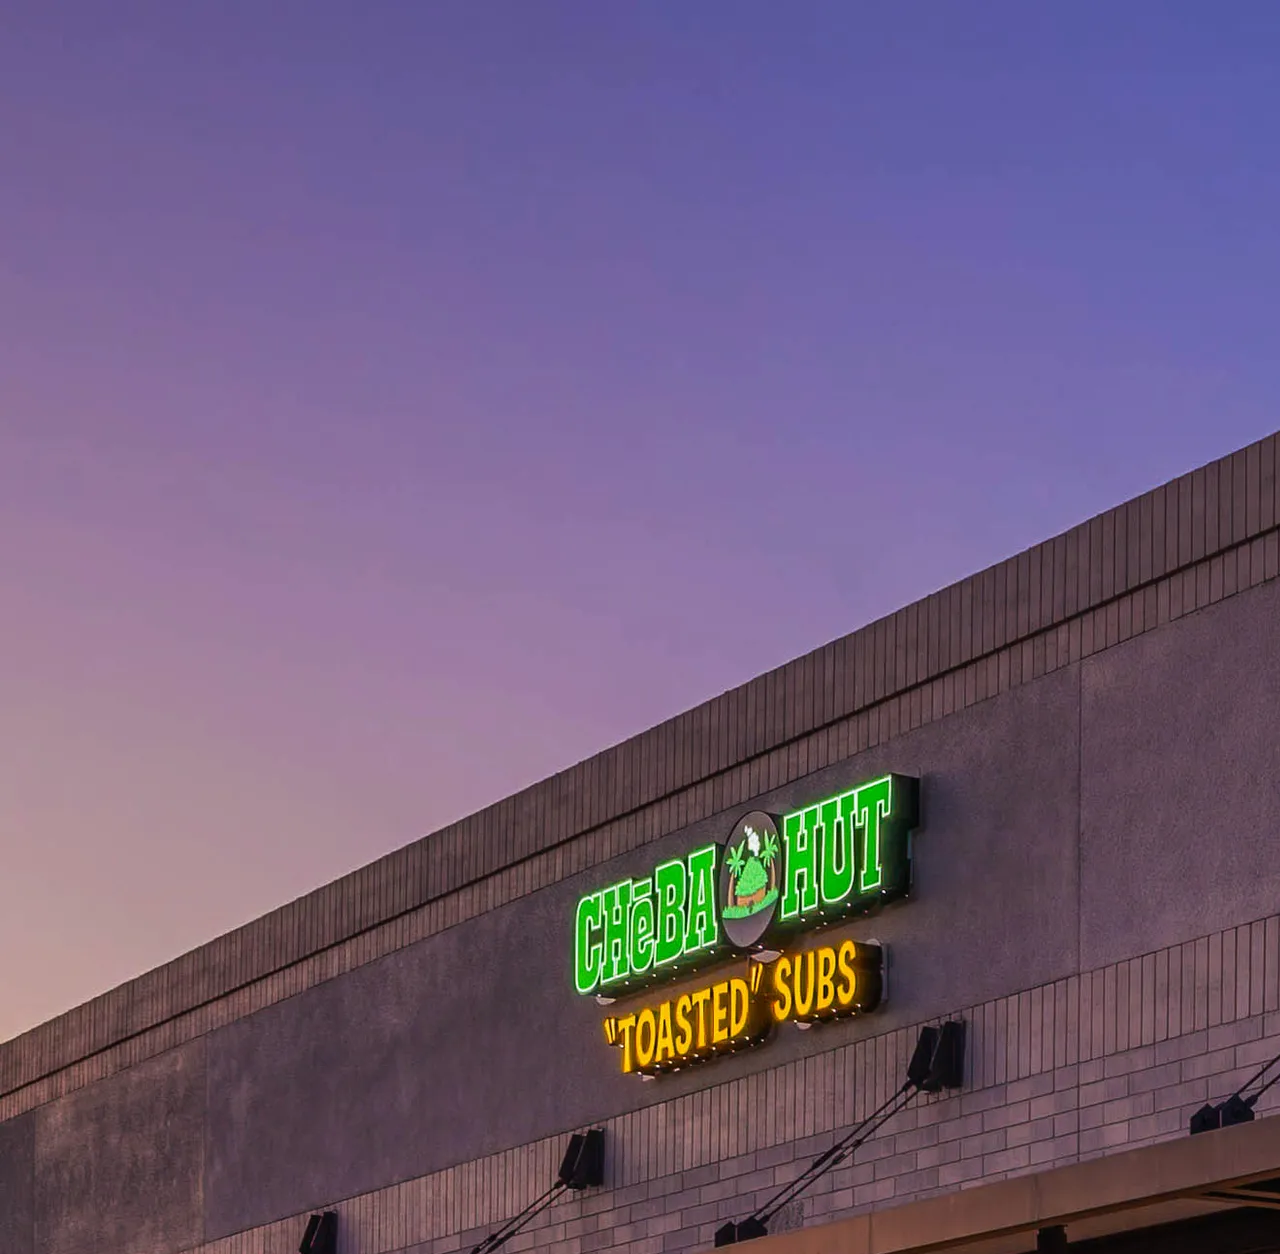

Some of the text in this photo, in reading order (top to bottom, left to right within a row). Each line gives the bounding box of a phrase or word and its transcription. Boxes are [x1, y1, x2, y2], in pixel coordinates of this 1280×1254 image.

[781, 774, 892, 919] HUT
[604, 940, 856, 1073] "TOASTED" SUBS
